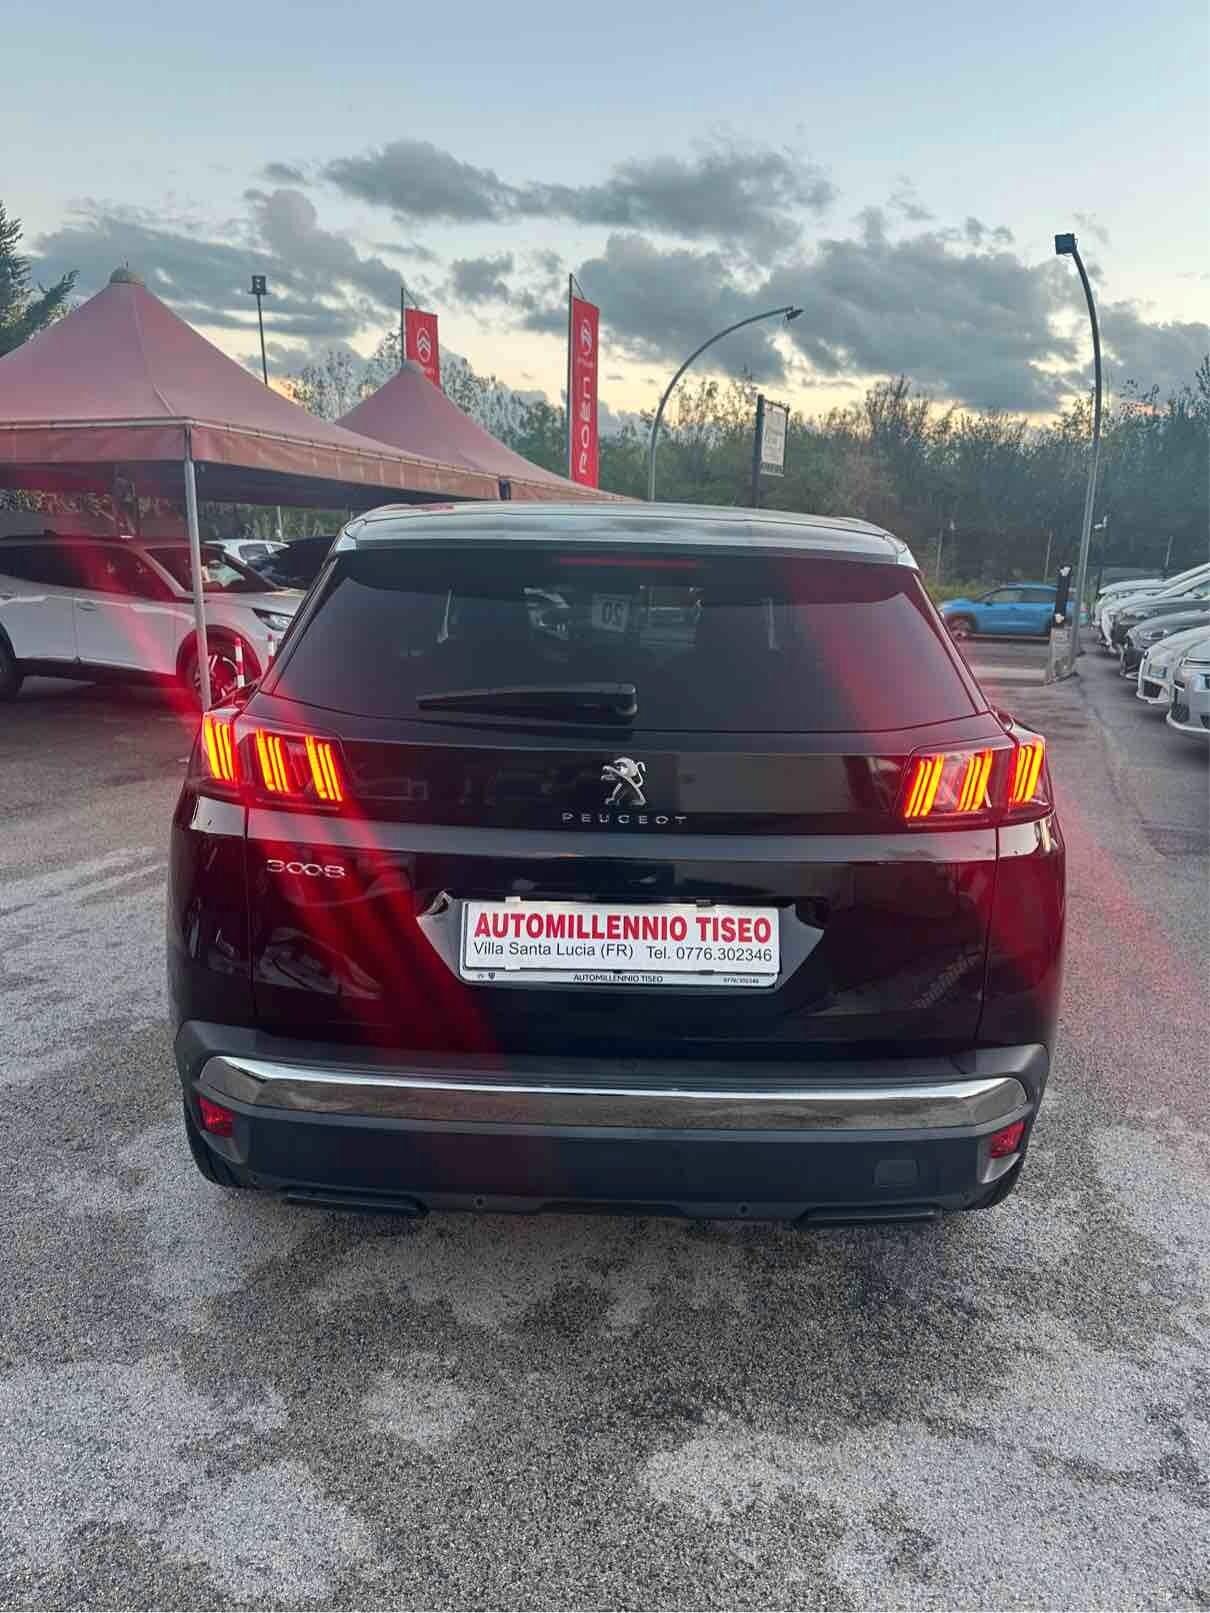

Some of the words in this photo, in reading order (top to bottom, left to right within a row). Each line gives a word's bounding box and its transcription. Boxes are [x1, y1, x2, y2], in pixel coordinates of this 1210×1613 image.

[561, 812, 687, 825] PEUGEOT
[266, 859, 345, 878] 3008
[474, 912, 688, 942] AUTOMILLENNIO
[696, 917, 772, 943] TISEO
[474, 942, 504, 955] Villa
[509, 943, 551, 955] Santa
[556, 944, 596, 956] Lucia
[601, 945, 634, 959] (FR)
[646, 946, 671, 959] Tel.
[676, 947, 772, 961] 0776.302346
[573, 974, 639, 982] AUTOMILLENNIO
[642, 975, 664, 983] TISEO
